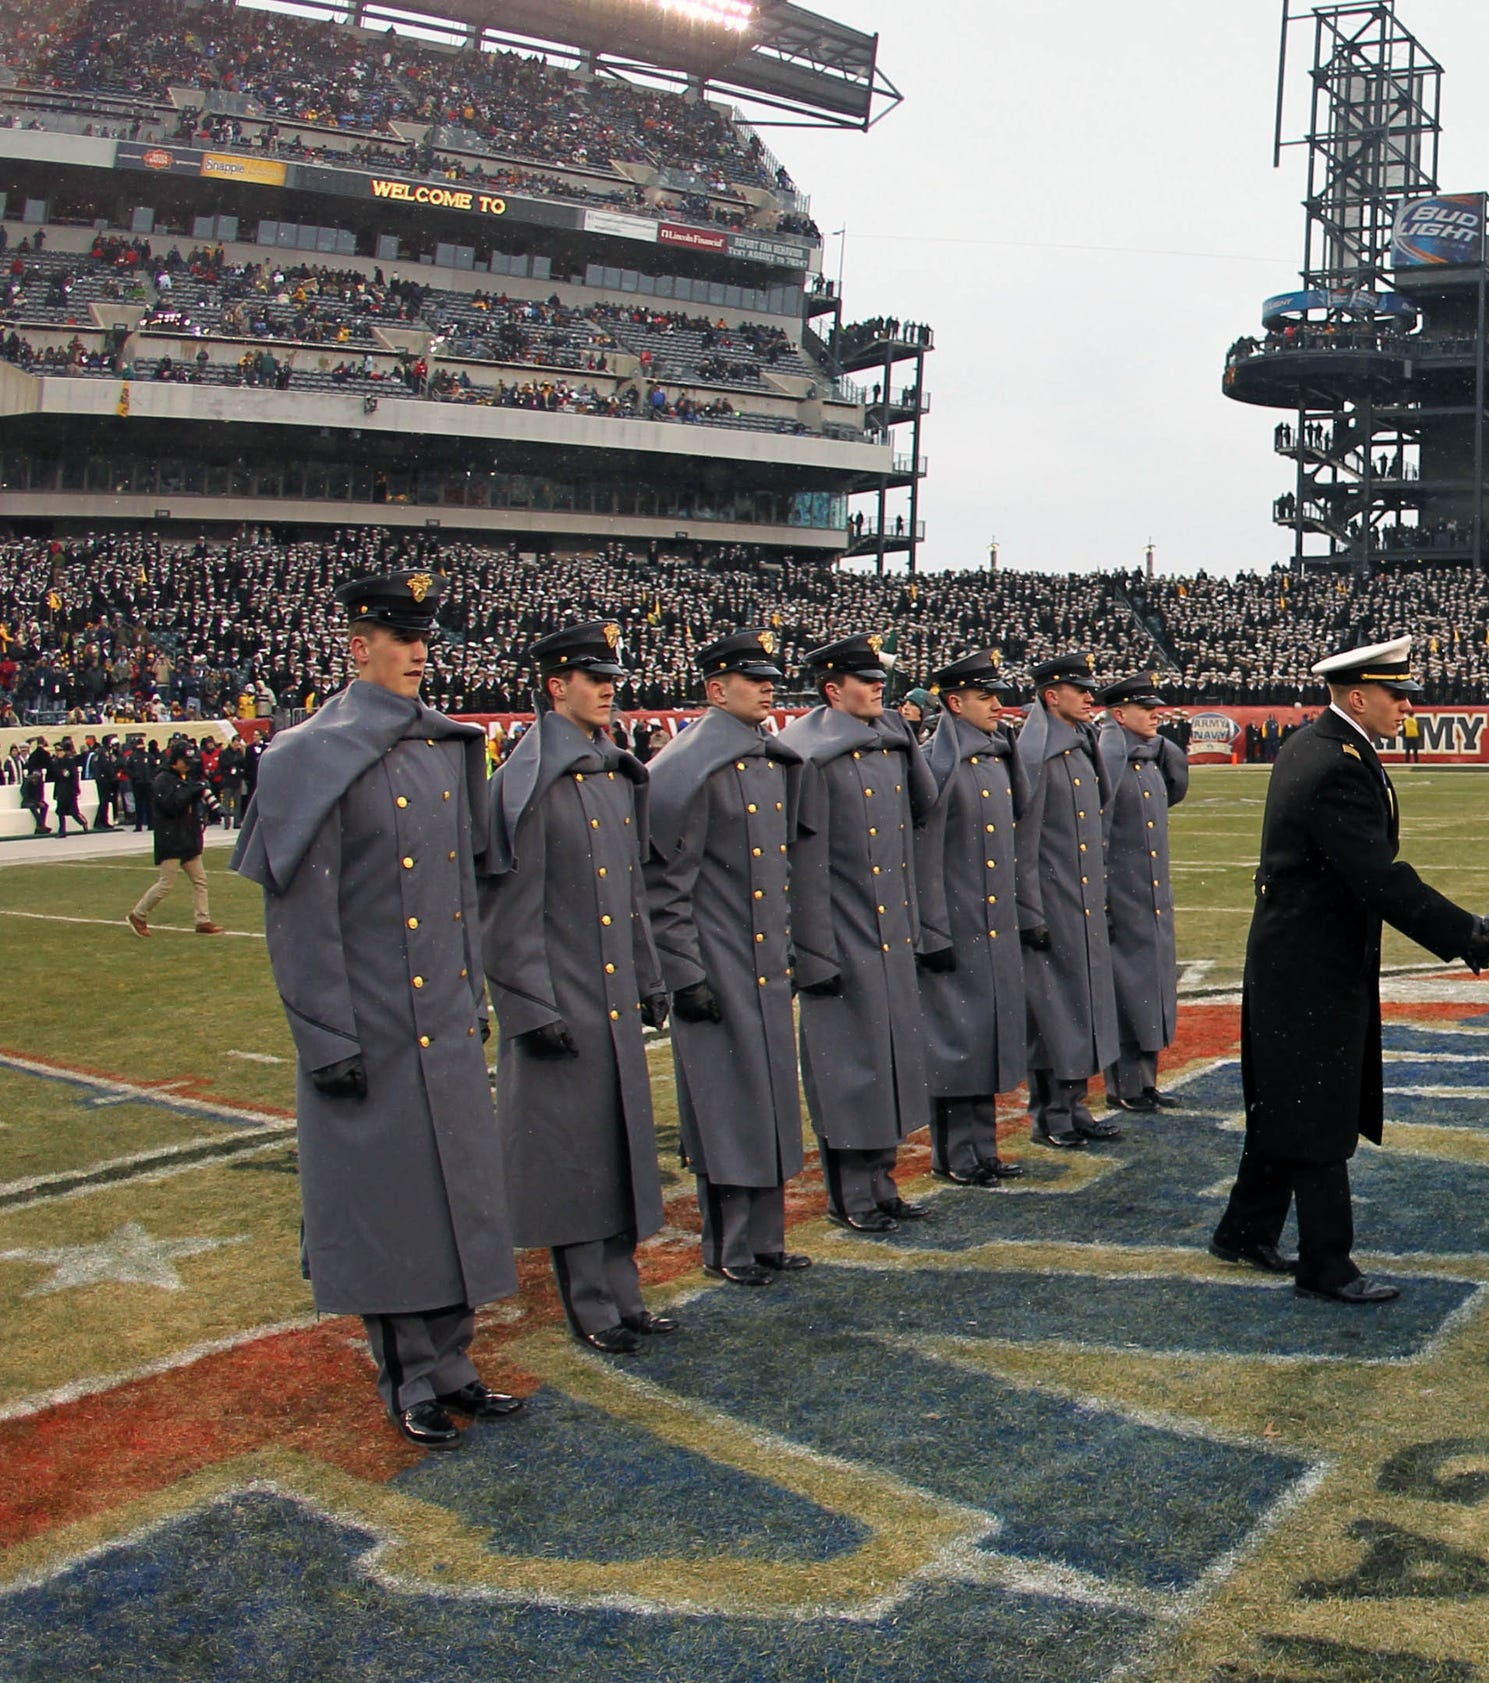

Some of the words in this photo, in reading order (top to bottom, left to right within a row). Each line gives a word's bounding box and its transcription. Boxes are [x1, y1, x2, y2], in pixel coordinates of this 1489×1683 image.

[206, 158, 245, 174] Snapple
[371, 180, 473, 210] WELCOME
[478, 196, 506, 215] TO
[1411, 206, 1479, 227] BUD
[669, 230, 693, 243] Lincoln
[693, 234, 724, 248] Financial
[1399, 222, 1479, 242] LIGHT
[1194, 719, 1228, 729] ARMY
[1193, 730, 1228, 739] NAVY
